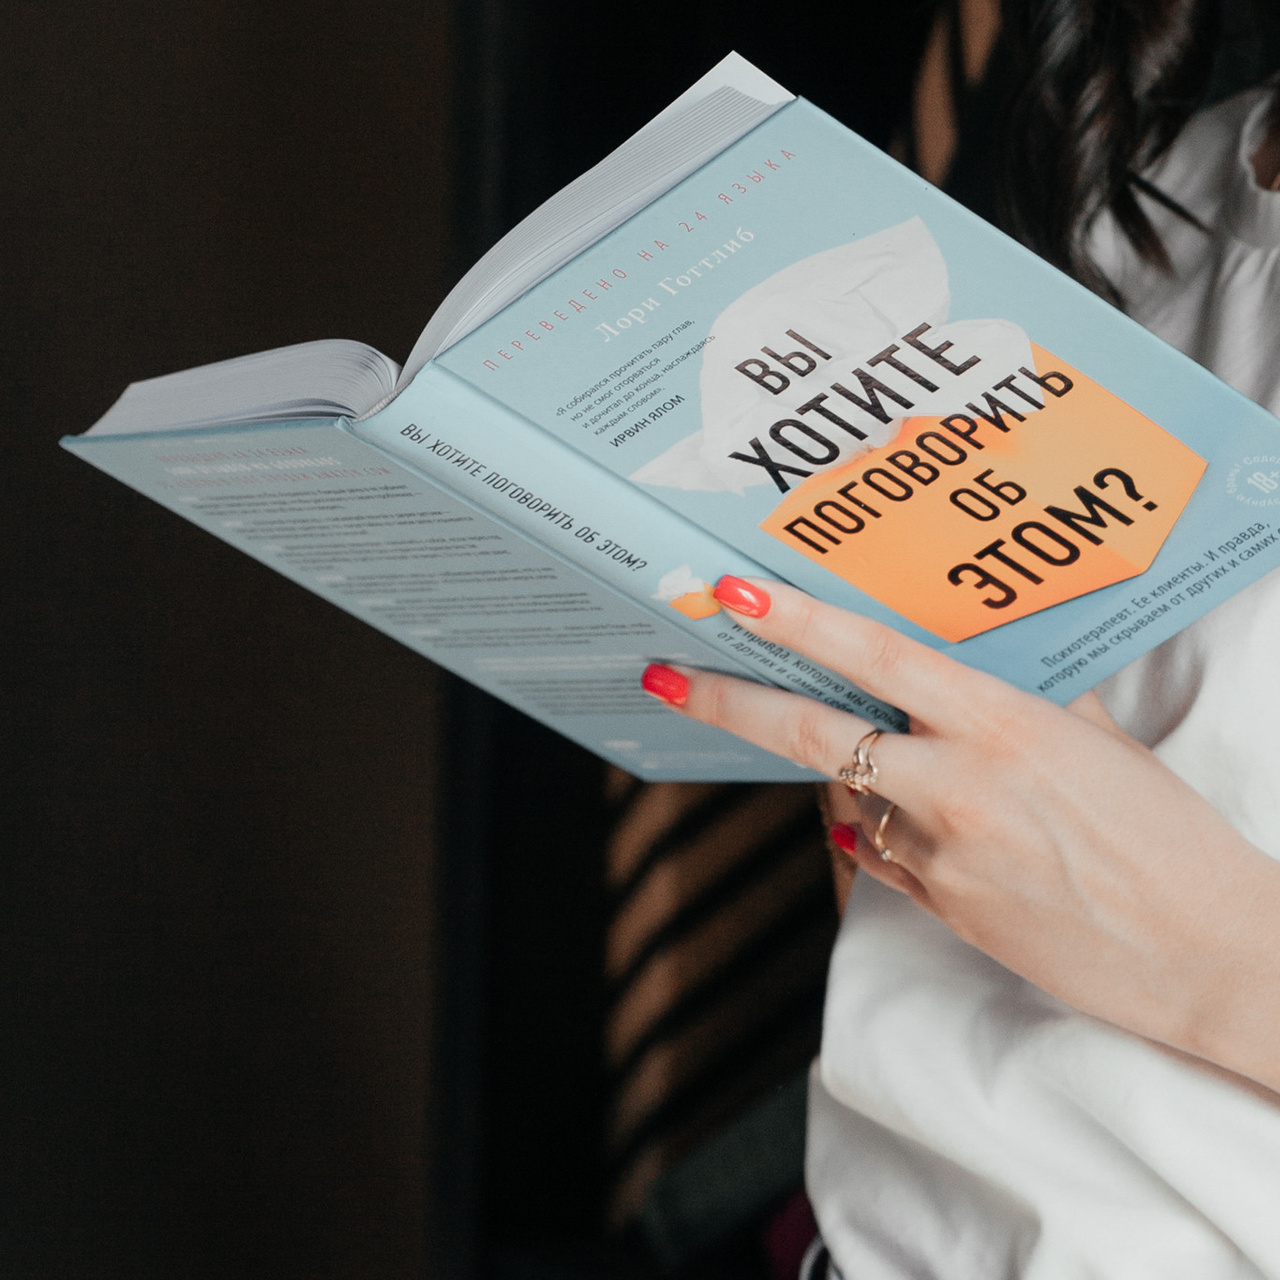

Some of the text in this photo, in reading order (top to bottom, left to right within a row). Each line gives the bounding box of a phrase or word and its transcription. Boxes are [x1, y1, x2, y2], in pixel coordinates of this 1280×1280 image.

[483, 149, 796, 371] ПЕРЕВЕДЕНО НА 24 ЯЗЫКА
[595, 227, 754, 343] Лори Готтлиб
[565, 376, 610, 410] собирался
[608, 348, 652, 380] прочитать
[651, 333, 674, 351] пару
[672, 318, 696, 336] глав,
[570, 356, 661, 422] но не смог оторваться
[589, 398, 624, 425] дочитал
[622, 390, 636, 402] до
[634, 372, 664, 393] конца,
[661, 334, 716, 374] наслаждаясь
[728, 323, 981, 494] ХОТИТЕ
[735, 329, 832, 396] ВЫ
[594, 410, 628, 436] каждым
[609, 393, 685, 448] ИРВИН ЯЛОМ
[783, 366, 1074, 555] ПОГОВОРИТЬ
[400, 422, 430, 446] ВЫ
[425, 436, 485, 478] ХОТИТЕ
[482, 470, 574, 531] ПОГОВОРИТЬ
[574, 524, 599, 544] ОБ
[596, 538, 648, 574] ЭТОМ?
[947, 467, 1158, 610] ЭТОМ?
[949, 468, 1027, 521] ОБ
[1036, 656, 1089, 694] которую
[1086, 642, 1110, 661] мы
[1108, 602, 1172, 647] скрываем
[1170, 592, 1186, 606] от
[1185, 564, 1230, 598] других
[1227, 557, 1240, 569] и
[1238, 532, 1279, 562] самих
[1040, 520, 1271, 669] Психотерапевт. Ее клиенты. И правда,
[716, 631, 734, 642] от
[732, 640, 776, 669] других
[786, 672, 824, 698] самих
[792, 658, 846, 696] которую
[844, 690, 868, 707] мы
